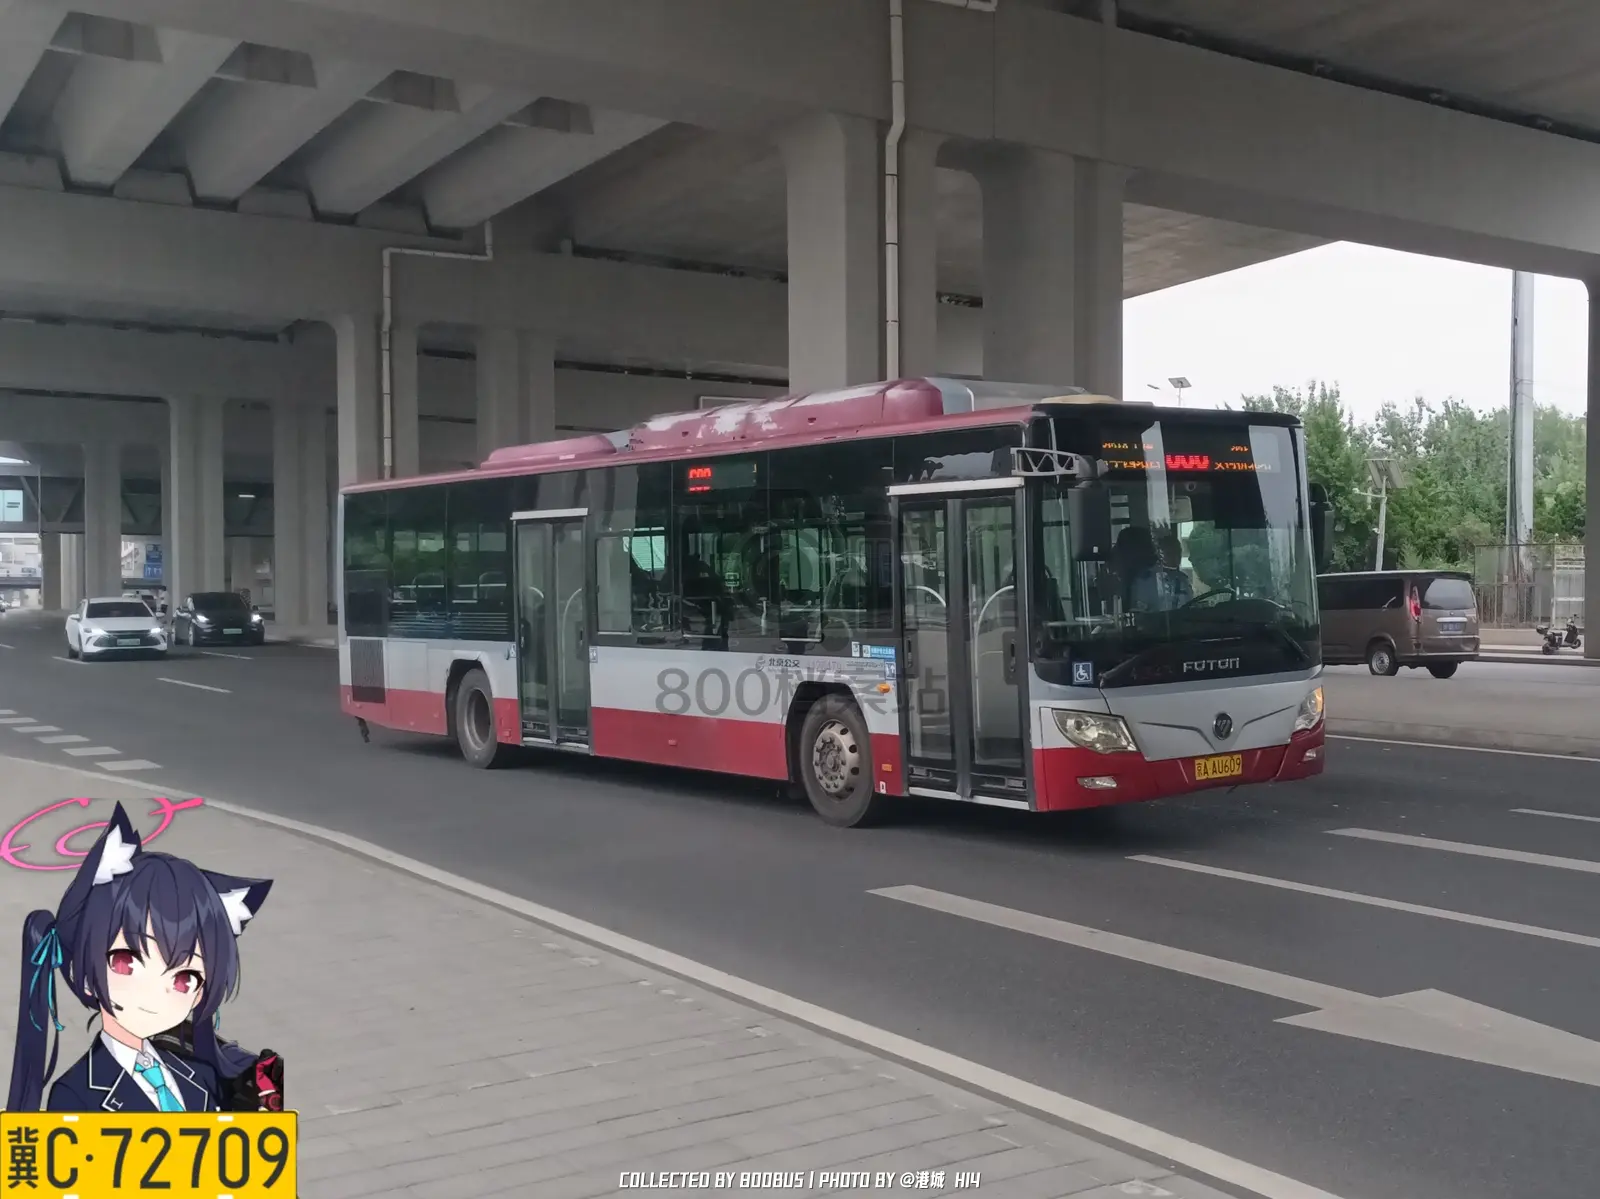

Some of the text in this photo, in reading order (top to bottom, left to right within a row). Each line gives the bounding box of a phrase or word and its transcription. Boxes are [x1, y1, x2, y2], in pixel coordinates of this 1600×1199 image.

[768, 657, 800, 668] 北京公交
[1183, 657, 1240, 673] FOTON
